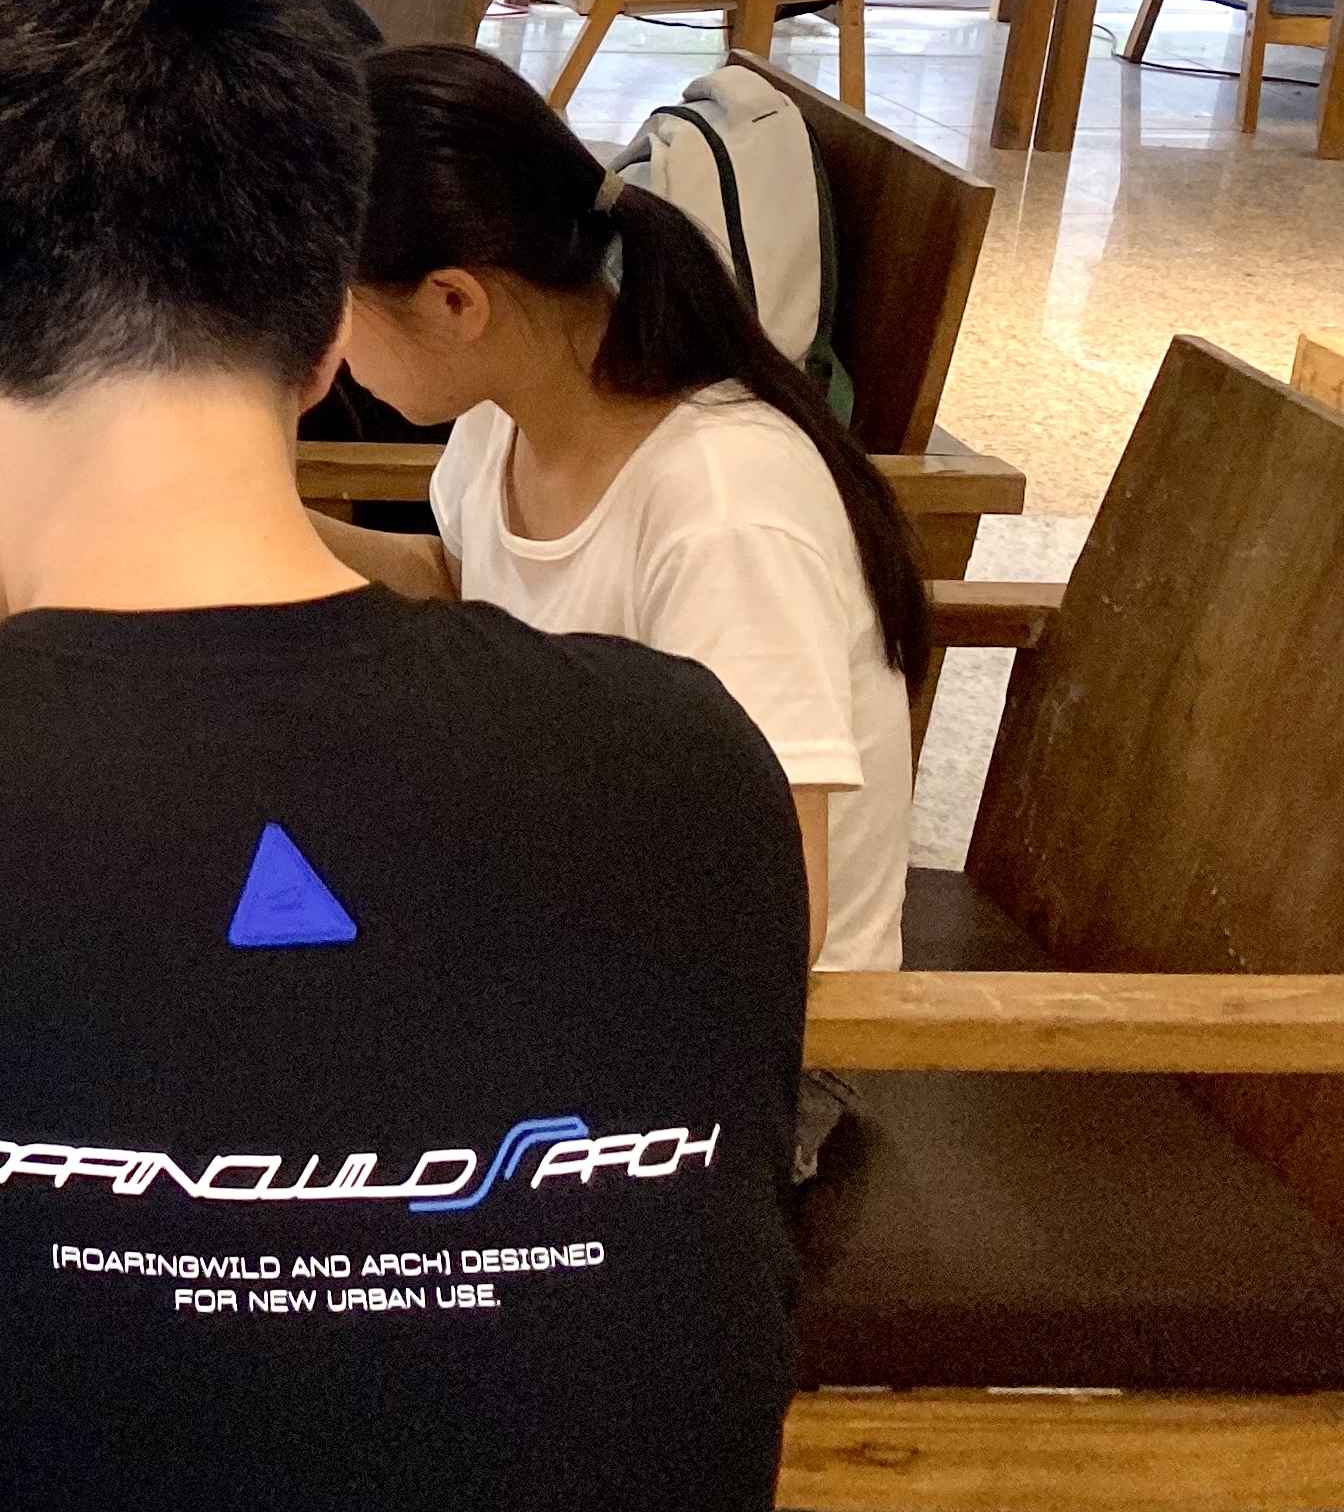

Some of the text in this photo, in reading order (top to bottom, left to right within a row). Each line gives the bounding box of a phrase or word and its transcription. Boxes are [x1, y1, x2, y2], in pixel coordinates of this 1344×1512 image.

[291, 1254, 351, 1279] AND
[460, 1241, 605, 1274] DESIGNED
[174, 1283, 501, 1313] FOR NEW URBAN USE.
